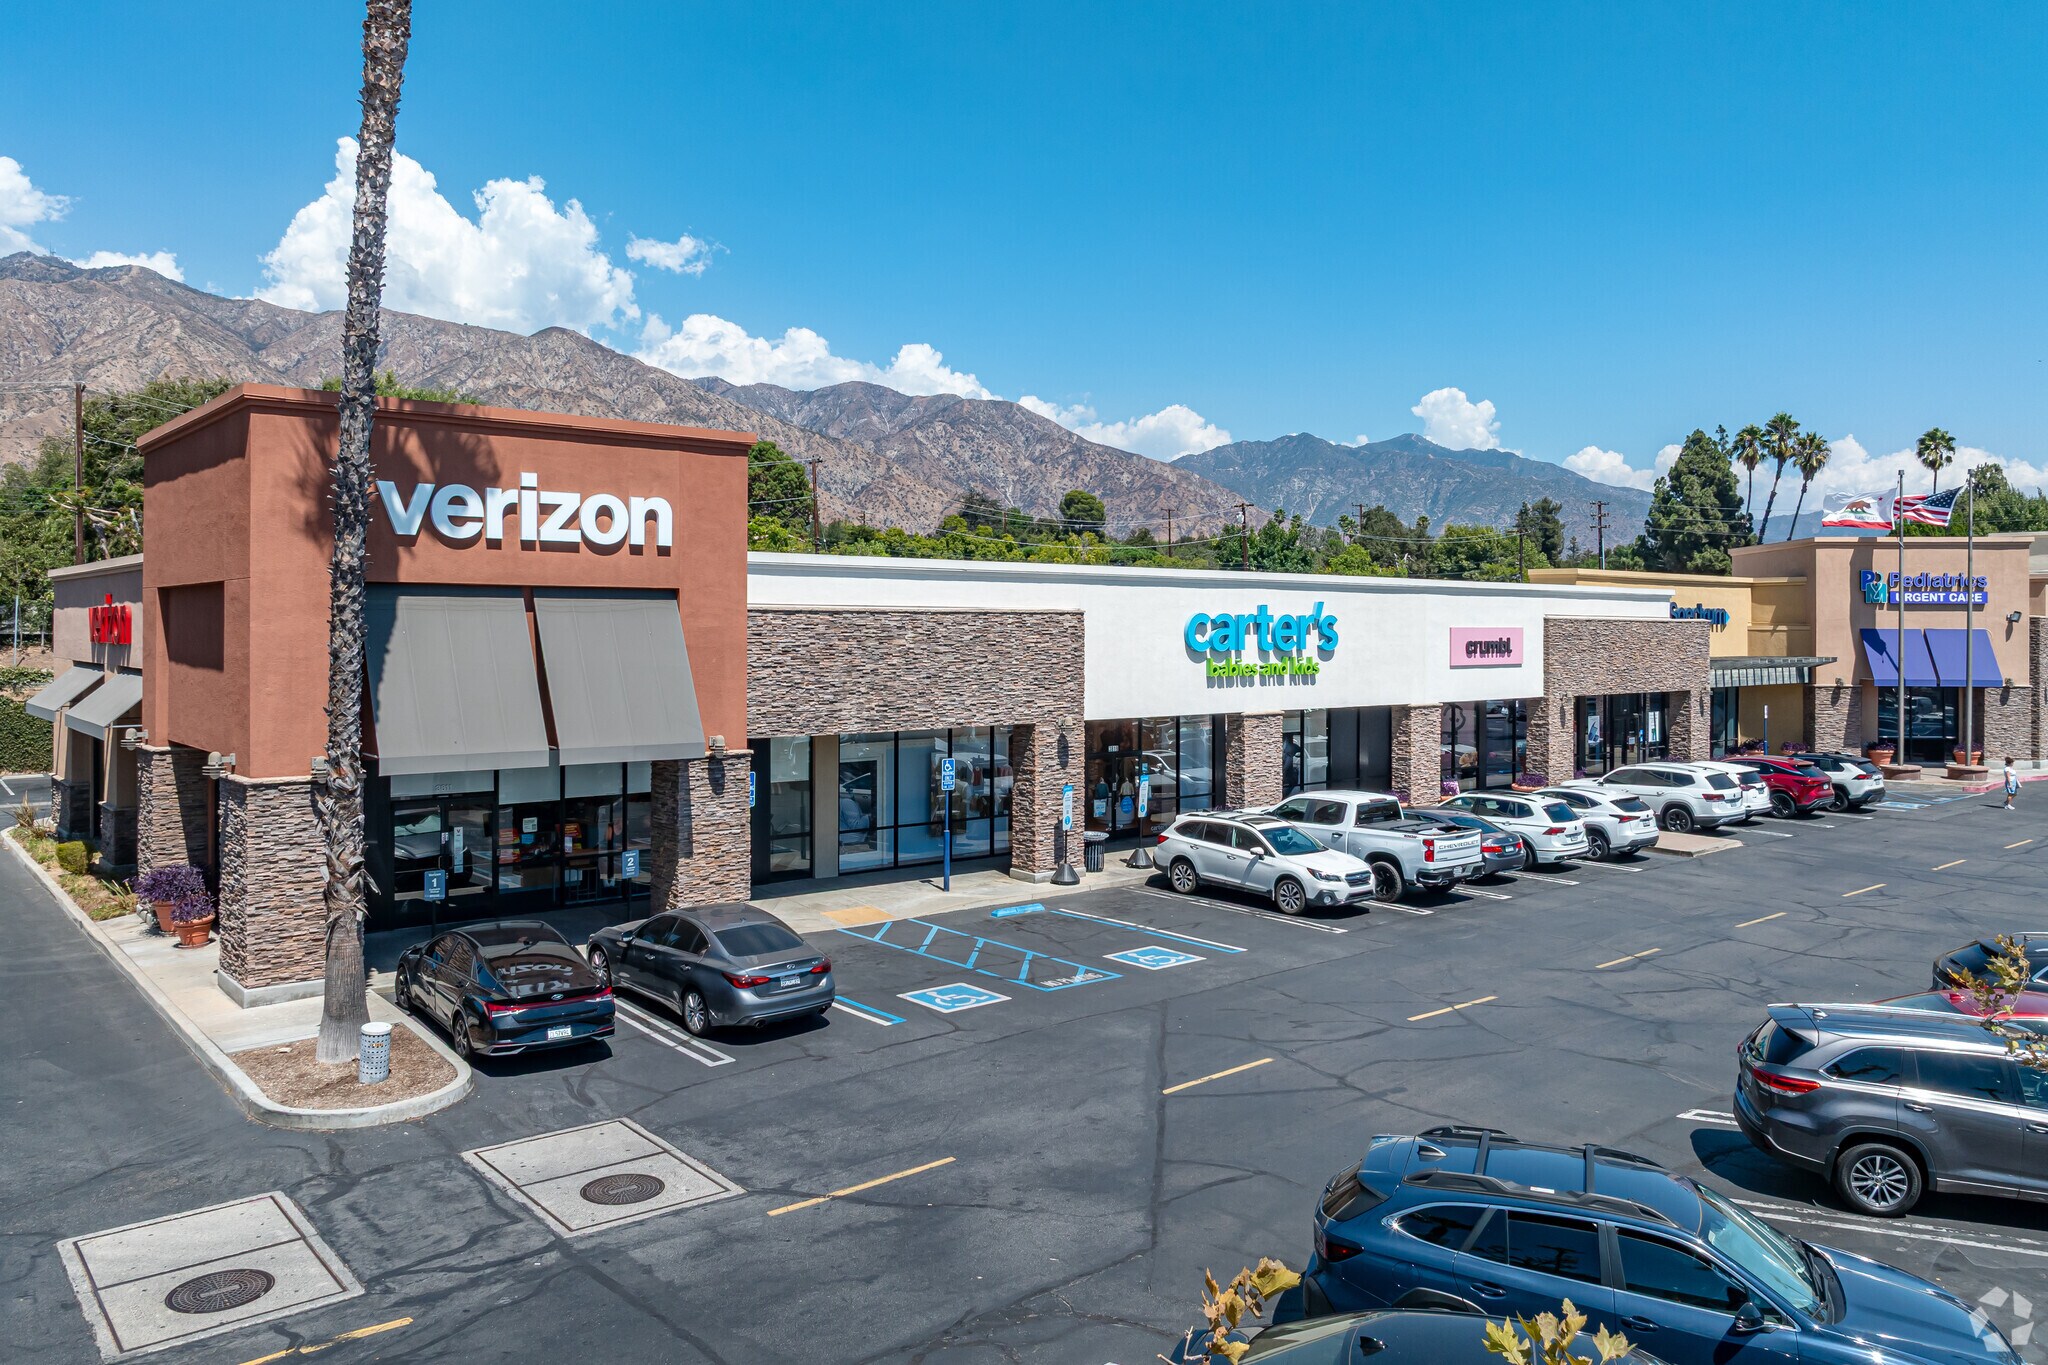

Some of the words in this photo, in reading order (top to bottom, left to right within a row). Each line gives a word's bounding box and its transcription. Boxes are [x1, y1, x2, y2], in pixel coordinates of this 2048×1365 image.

[376, 472, 673, 547] verizon
[89, 593, 132, 644] verizon
[1184, 601, 1339, 652] carter's
[1466, 637, 1512, 654] crumbl
[1206, 657, 1258, 677] babies
[1260, 656, 1288, 676] and
[1289, 656, 1320, 676] kids
[1439, 840, 1479, 850] CHEVROLET
[627, 857, 634, 867] 2
[431, 878, 437, 887] 1
